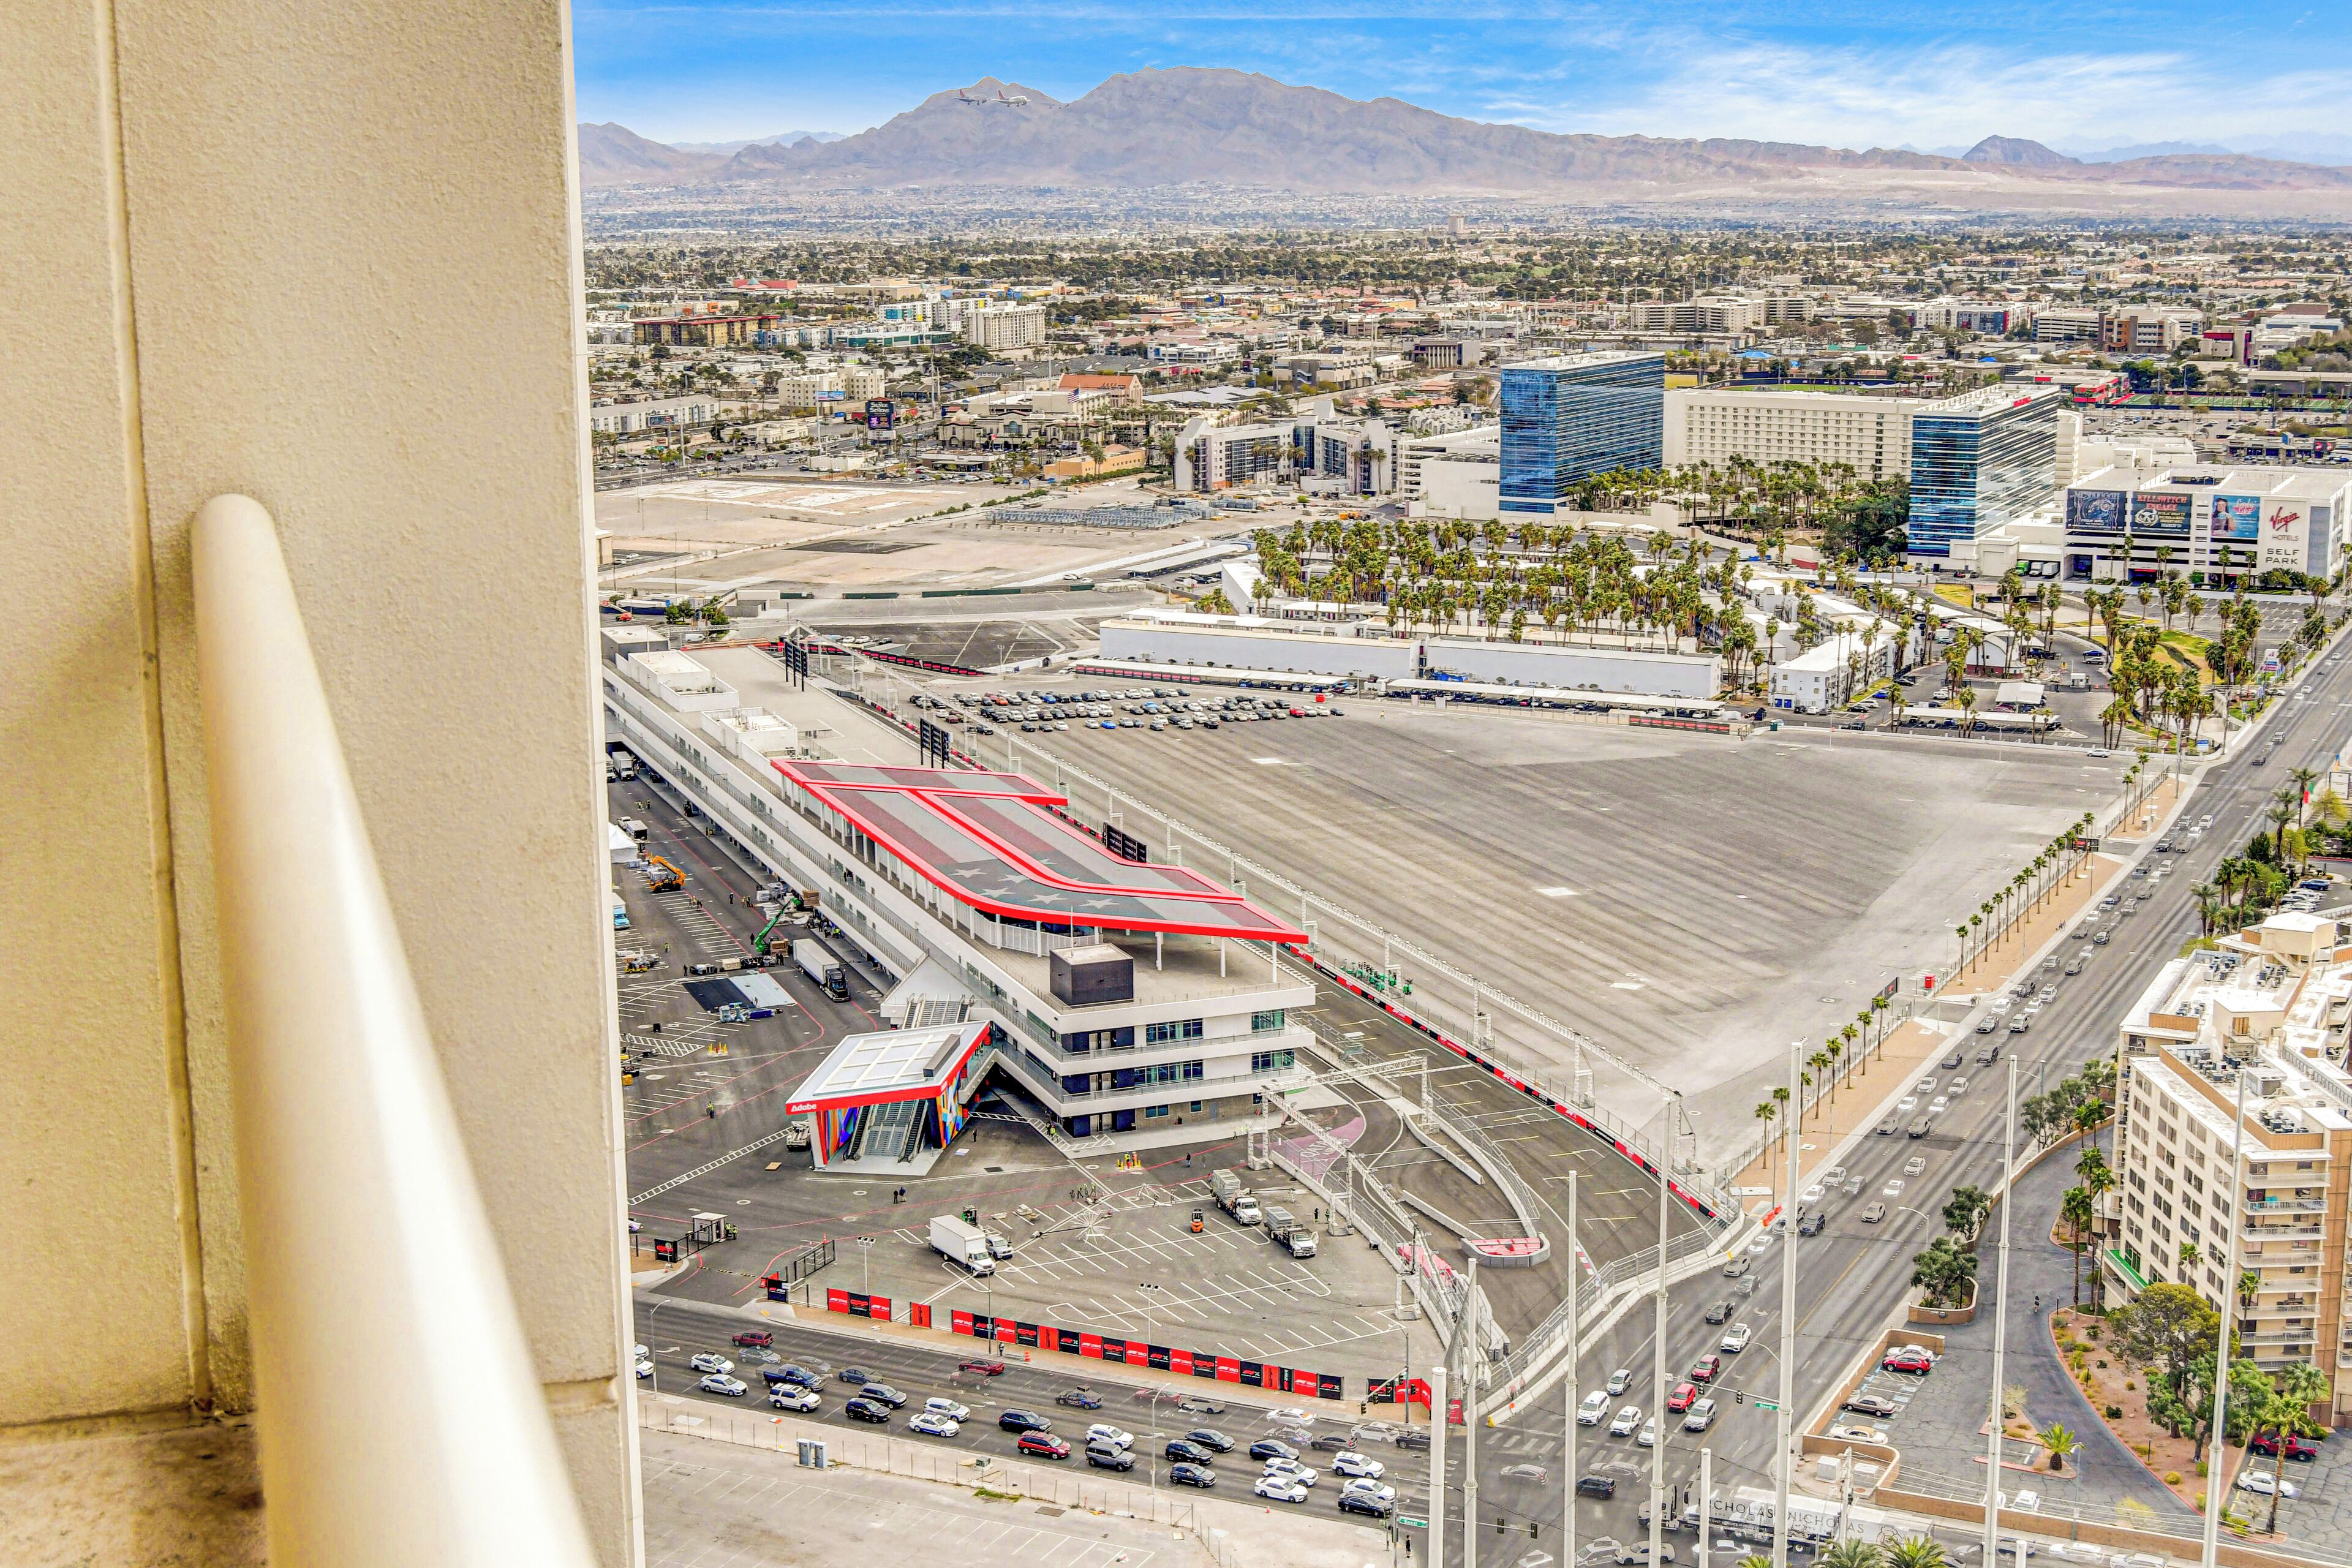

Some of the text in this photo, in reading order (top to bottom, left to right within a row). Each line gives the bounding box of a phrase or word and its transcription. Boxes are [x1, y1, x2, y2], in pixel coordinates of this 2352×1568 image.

[2269, 507, 2300, 532] Virgin
[791, 1103, 817, 1112] Adobe
[1788, 1511, 1864, 1533] NICHOAS
